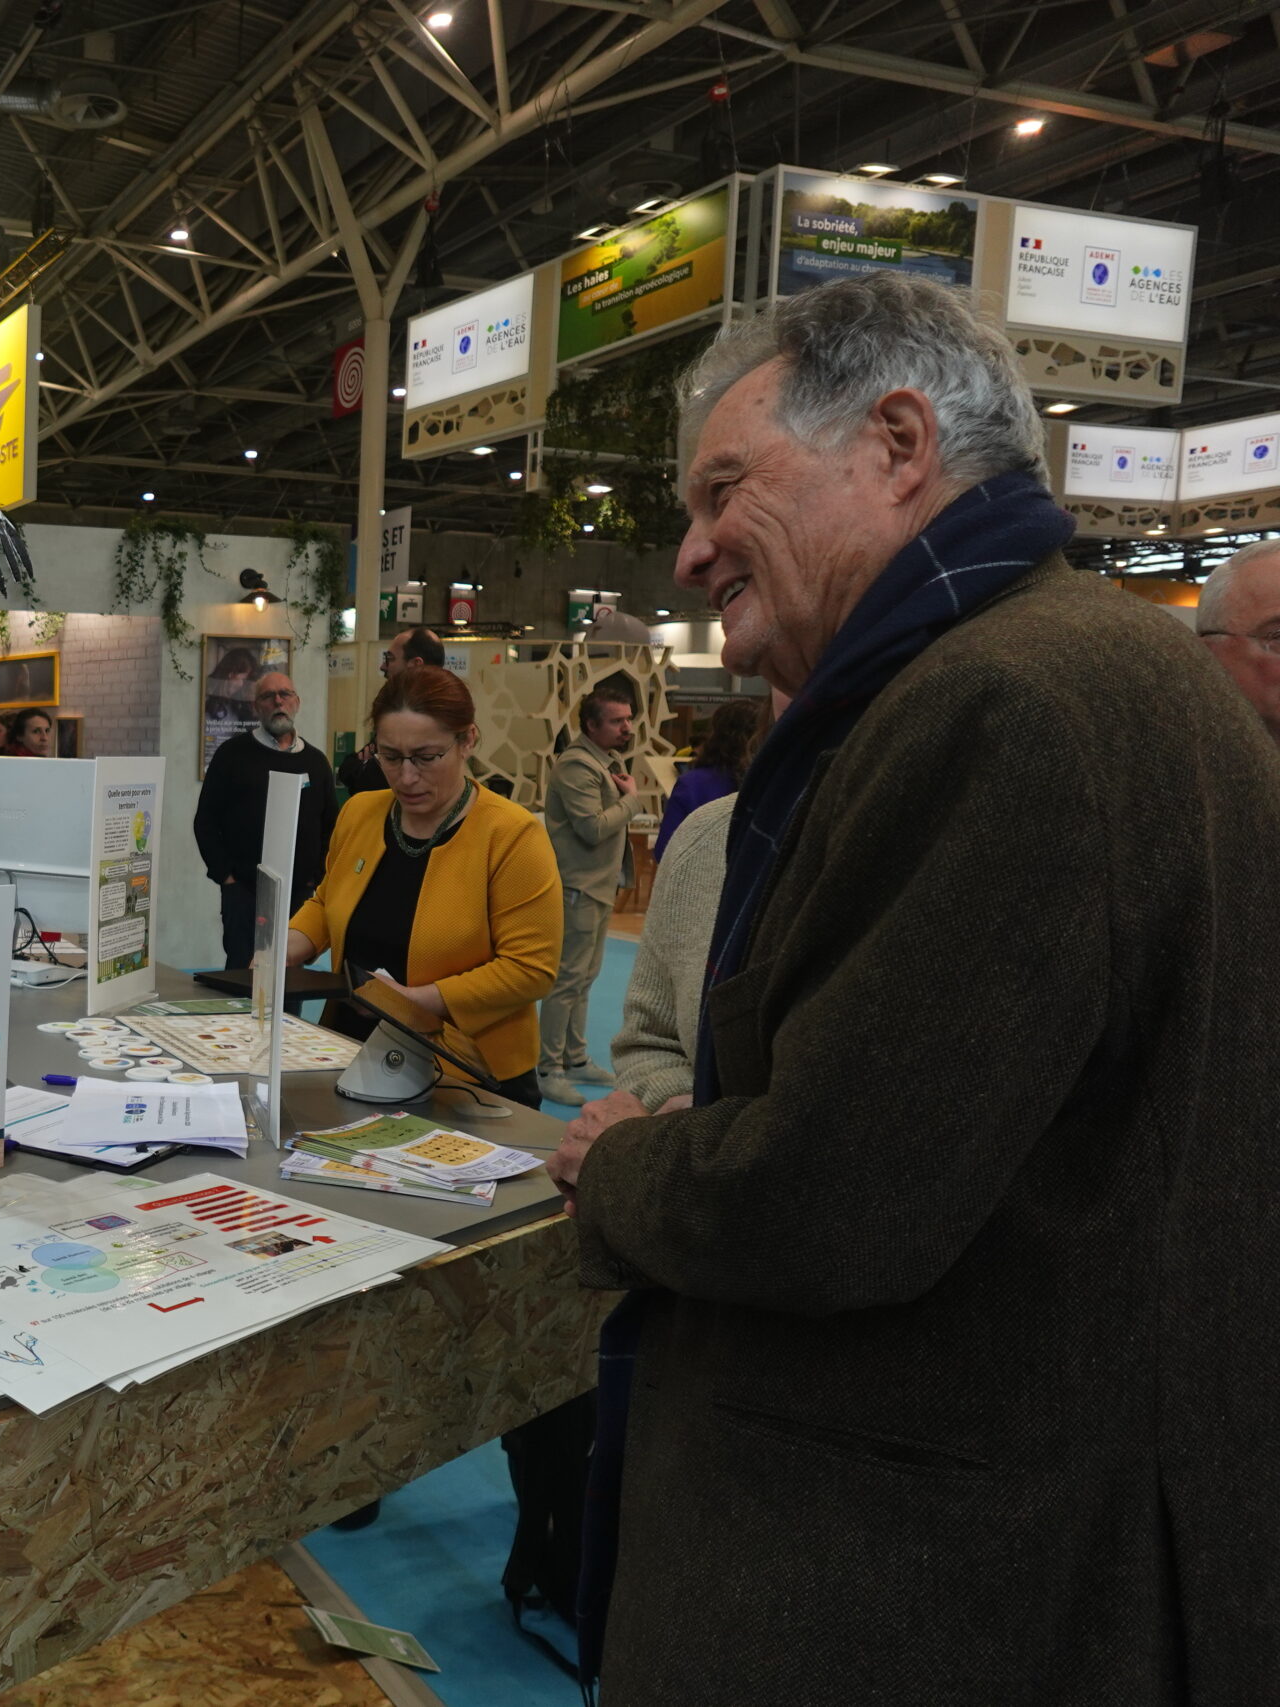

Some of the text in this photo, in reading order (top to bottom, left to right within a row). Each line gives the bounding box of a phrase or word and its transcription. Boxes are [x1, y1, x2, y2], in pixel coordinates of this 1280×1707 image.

[798, 216, 858, 236] La sobriété,
[822, 237, 896, 259] enjeu majeur
[797, 254, 848, 271] d'adaptation
[850, 263, 860, 271] au
[1019, 252, 1070, 267] RÉPUBLIQUE
[1089, 252, 1115, 261] ADEME
[1018, 263, 1065, 277] FRANÇAISE
[1162, 269, 1183, 281] LES
[567, 270, 609, 296] Les haies
[595, 266, 689, 311] la transition agroécologique
[1129, 279, 1182, 294] AGENCES
[1131, 290, 1180, 306] DE L'EAU
[486, 324, 526, 344] AGENCES
[501, 334, 525, 350] L'EAU
[413, 344, 444, 360] RÉPUBLIQUE
[413, 354, 442, 368] FRANÇAISE
[392, 526, 404, 546] ET
[108, 790, 120, 798] Quelle
